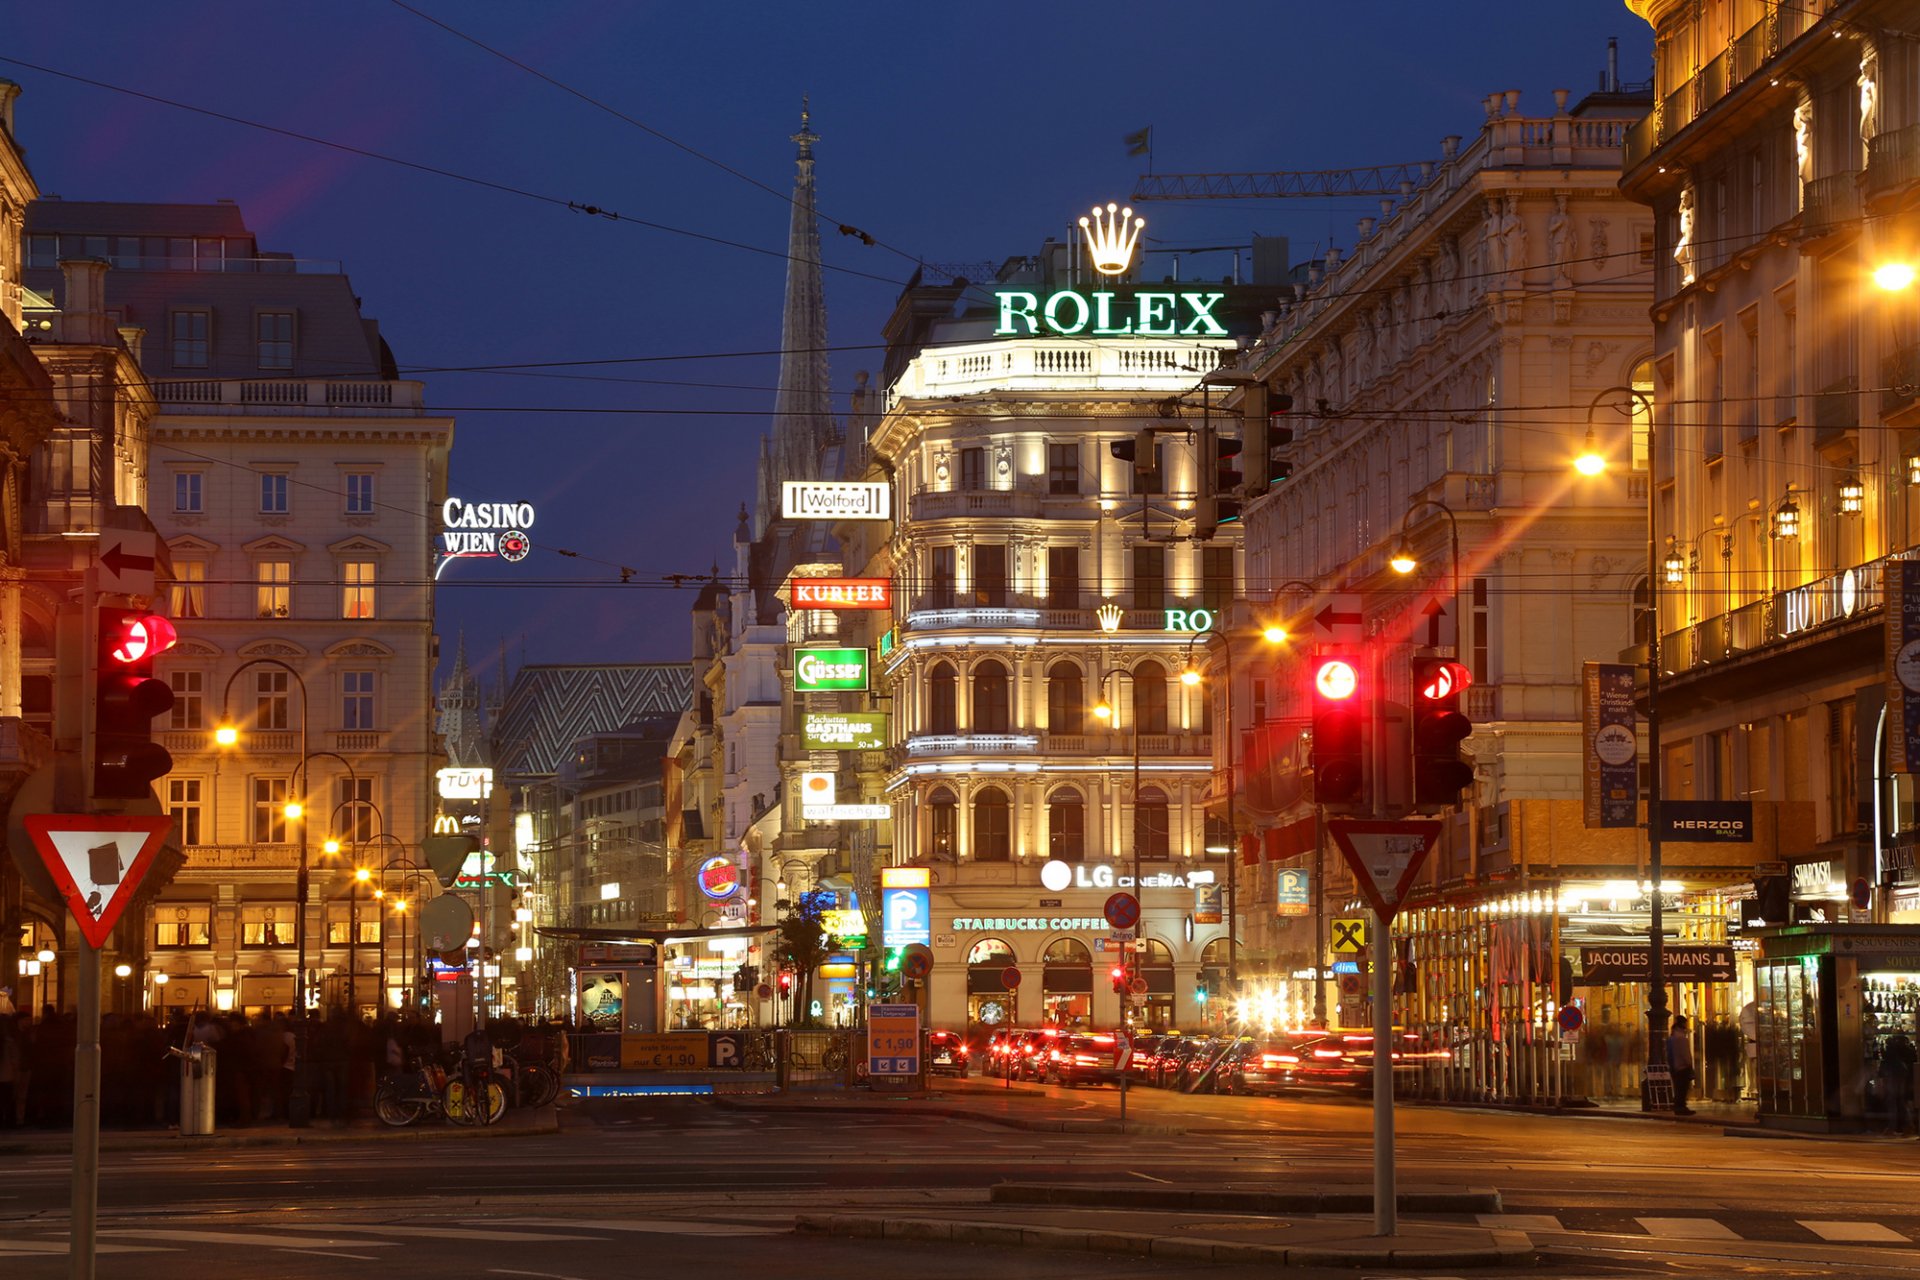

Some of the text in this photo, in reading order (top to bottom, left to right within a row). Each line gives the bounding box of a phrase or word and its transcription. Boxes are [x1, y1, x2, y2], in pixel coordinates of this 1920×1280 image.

[994, 291, 1228, 335] ROLEX
[808, 493, 865, 507] Wolford
[443, 498, 535, 528] CASINO
[443, 532, 495, 552] WIEN
[797, 585, 885, 601] KURIER
[1786, 575, 1842, 634] HOTEL
[1165, 609, 1217, 632] RO
[798, 655, 863, 685] Gösser
[805, 723, 873, 734] GASTHAUS
[1673, 820, 1743, 829] HERZOG
[1077, 865, 1113, 888] LG
[1794, 861, 1831, 888] SWAROVSKI
[953, 918, 1110, 930] STARBUCKS COFFEE
[1587, 953, 1649, 965] JACQUES
[1663, 953, 1711, 965] EMANS
